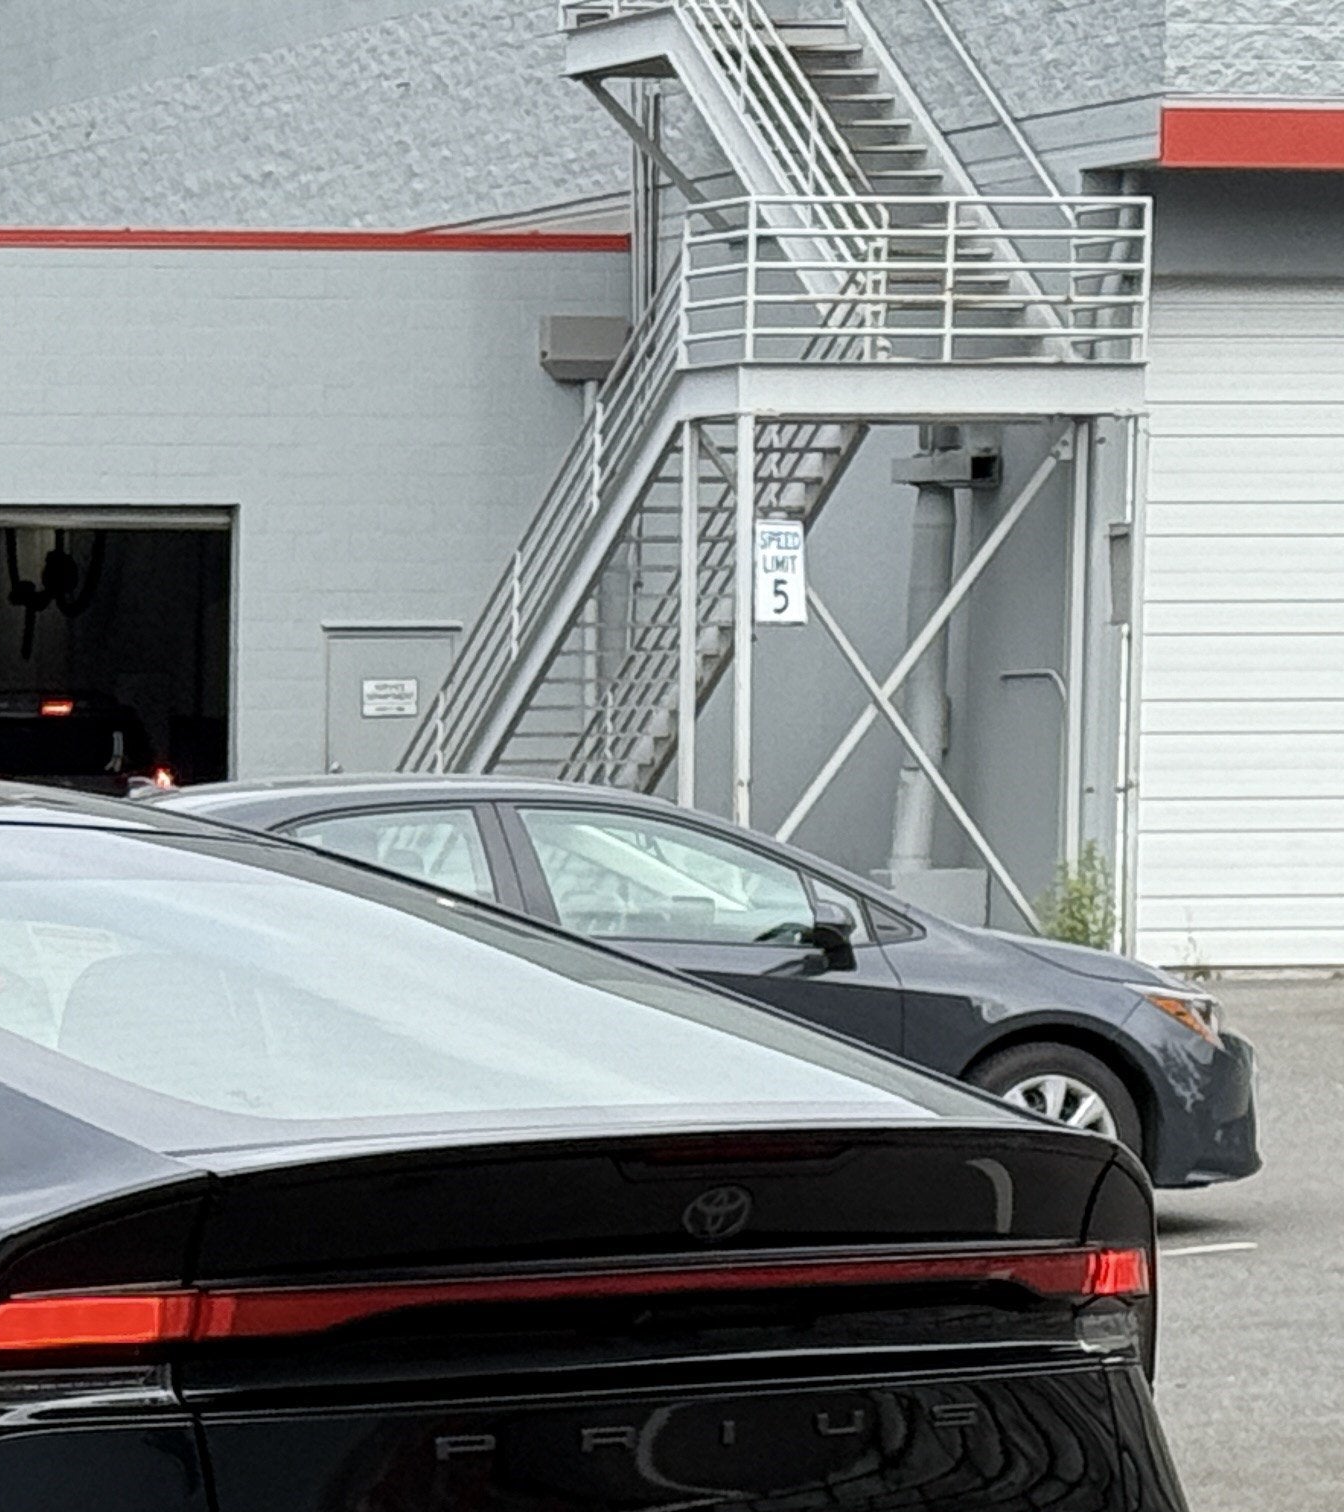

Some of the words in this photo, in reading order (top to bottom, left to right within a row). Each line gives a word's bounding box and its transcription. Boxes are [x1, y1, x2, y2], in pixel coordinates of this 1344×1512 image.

[760, 531, 801, 550] SPEED
[762, 554, 798, 574] LIMIT
[773, 578, 789, 614] 5
[434, 1402, 981, 1462] PRIUS
